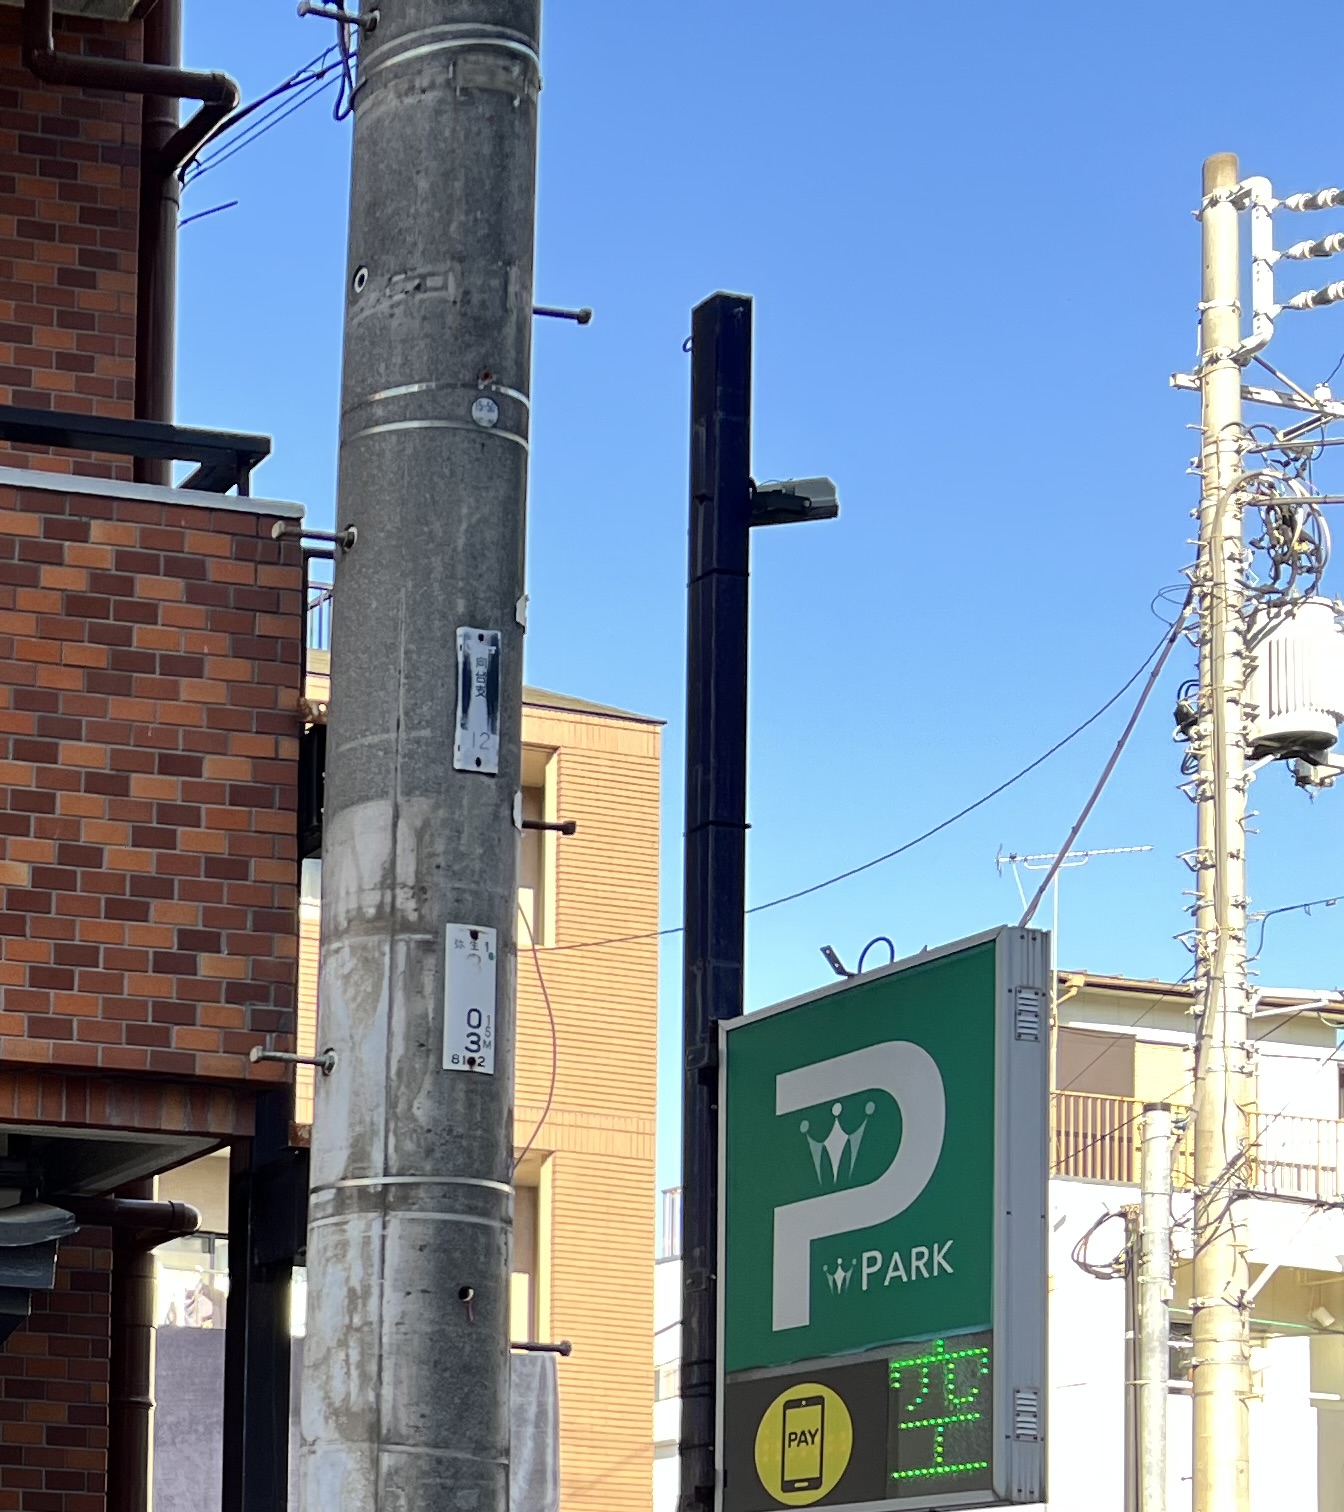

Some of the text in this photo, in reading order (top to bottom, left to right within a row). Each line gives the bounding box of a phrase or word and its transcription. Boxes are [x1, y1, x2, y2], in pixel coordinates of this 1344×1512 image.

[472, 731, 491, 751] 12
[451, 1053, 486, 1068] 812
[772, 1040, 947, 1332] P
[860, 1240, 955, 1291] PARK
[889, 1338, 989, 1478] 空
[788, 1427, 820, 1449] PAY
